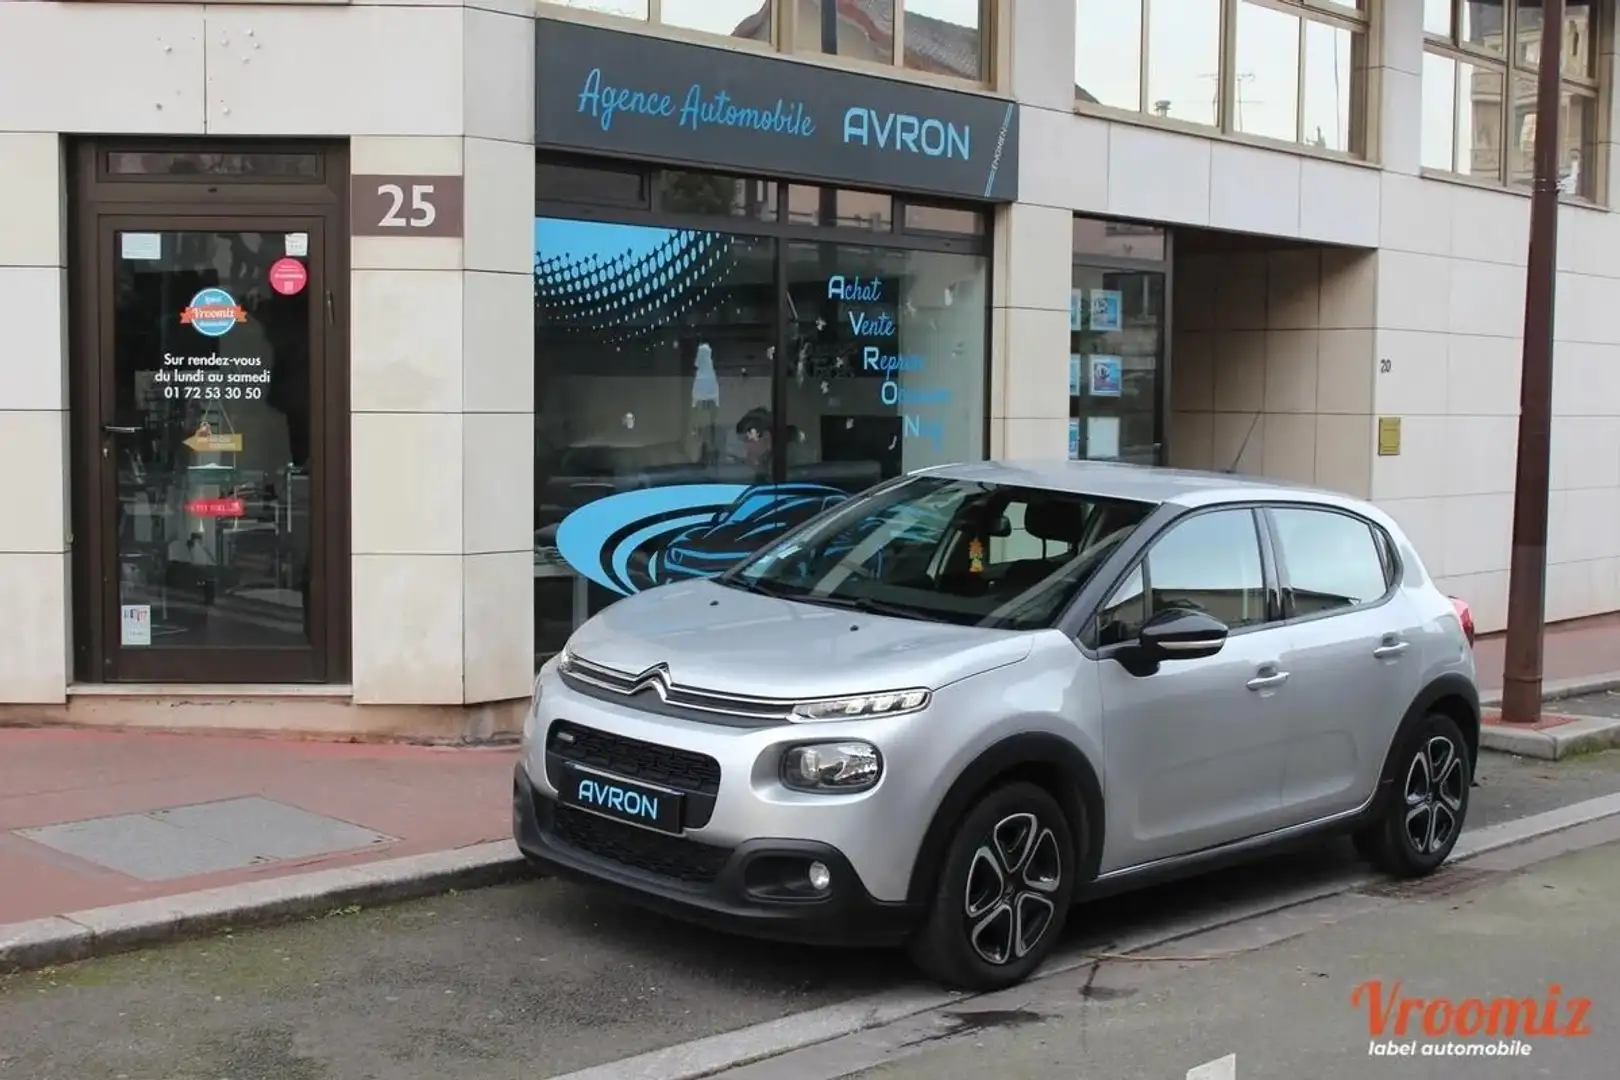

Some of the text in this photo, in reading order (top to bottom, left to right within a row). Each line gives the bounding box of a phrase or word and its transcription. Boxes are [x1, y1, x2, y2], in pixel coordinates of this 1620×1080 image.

[577, 67, 817, 138] Agence Automobile
[843, 106, 971, 161] AVRON
[377, 183, 436, 227] 25
[827, 275, 882, 301] Achat
[848, 311, 896, 336] Vente
[163, 352, 261, 366] Sur rendez-vous
[863, 346, 926, 381] Repr
[1380, 359, 1392, 373] 20
[154, 369, 271, 383] du lundi au samedi
[163, 386, 261, 399] 01 72 53 30 50
[578, 779, 658, 820] AVRON
